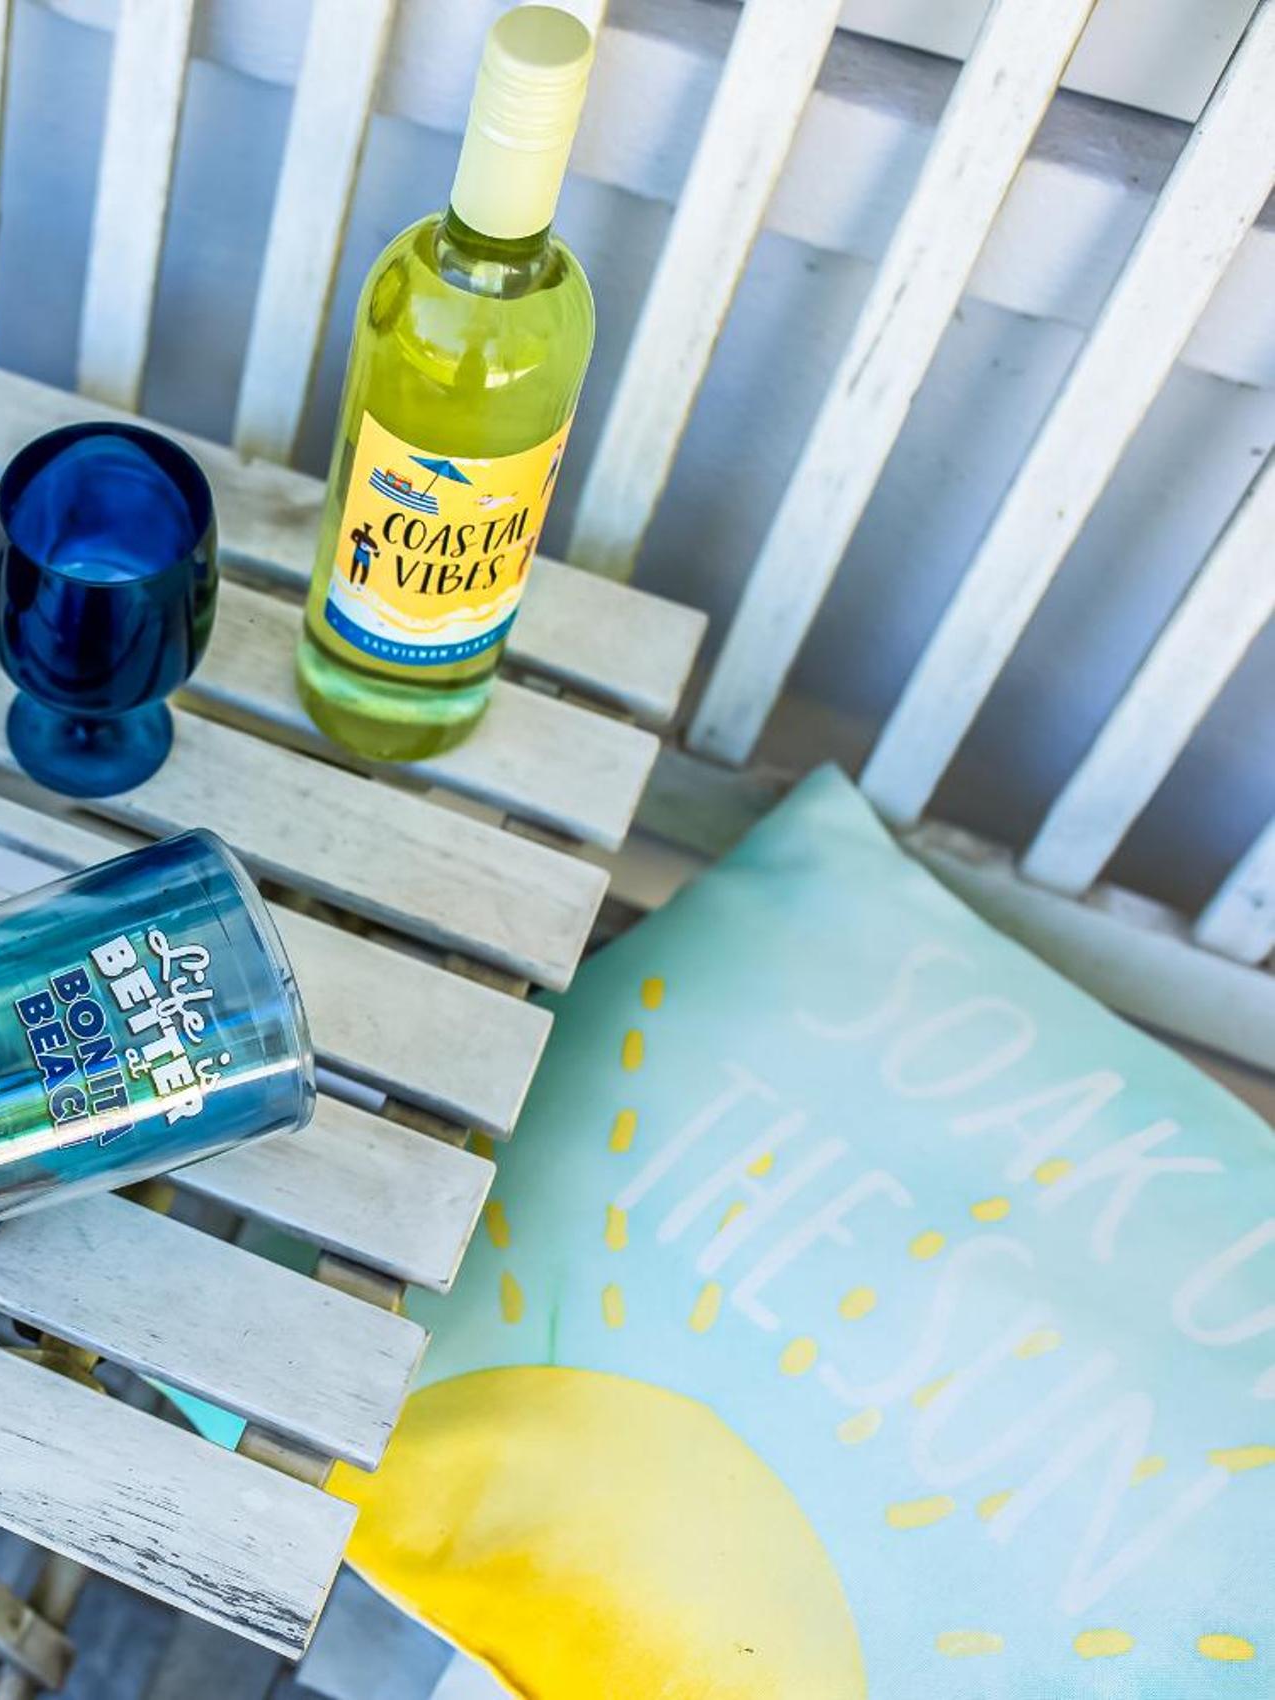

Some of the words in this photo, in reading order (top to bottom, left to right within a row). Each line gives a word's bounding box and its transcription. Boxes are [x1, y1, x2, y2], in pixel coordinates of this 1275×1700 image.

[381, 506, 530, 560] COASTAL
[395, 554, 505, 596] VIBES
[50, 963, 135, 1147] BONIT
[91, 934, 204, 1127] BETTER
[146, 925, 214, 1044] Life
[125, 1047, 153, 1080] at
[793, 942, 1228, 1264] SOAK
[1172, 1217, 1275, 1400] U
[613, 1058, 915, 1332] THE
[818, 1232, 1232, 1617] SUN
